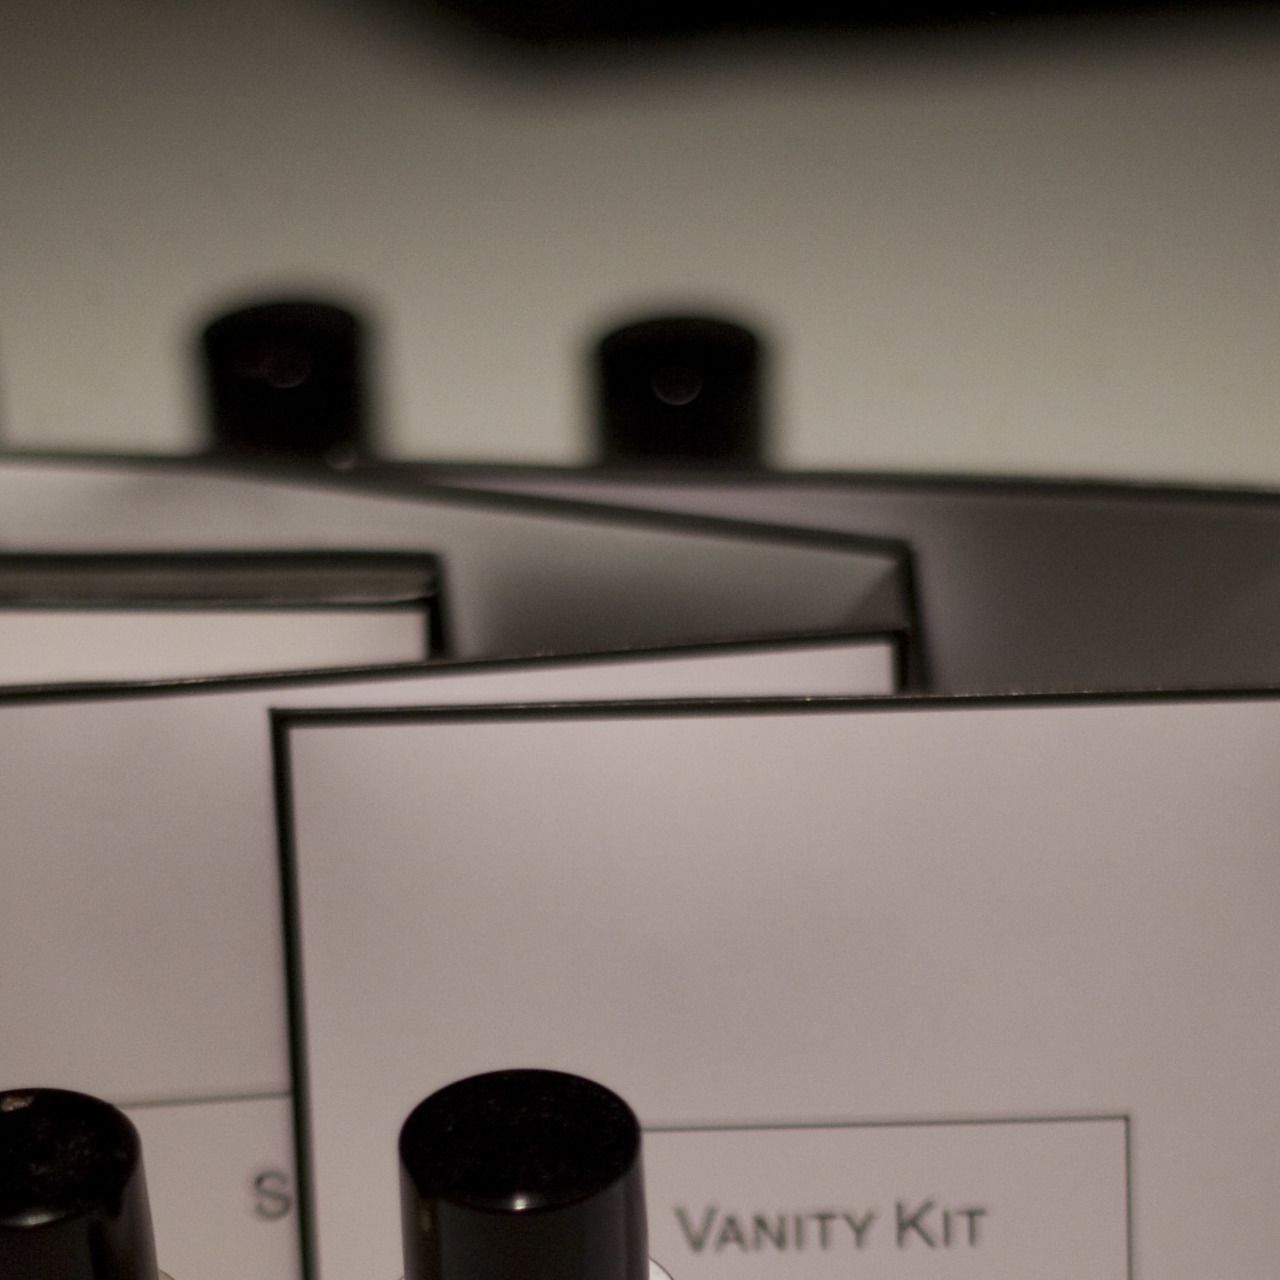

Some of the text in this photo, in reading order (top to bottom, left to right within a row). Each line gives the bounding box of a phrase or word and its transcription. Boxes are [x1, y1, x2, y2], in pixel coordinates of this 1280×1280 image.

[254, 1168, 292, 1221] S
[673, 1198, 988, 1254] VANITY KIT
